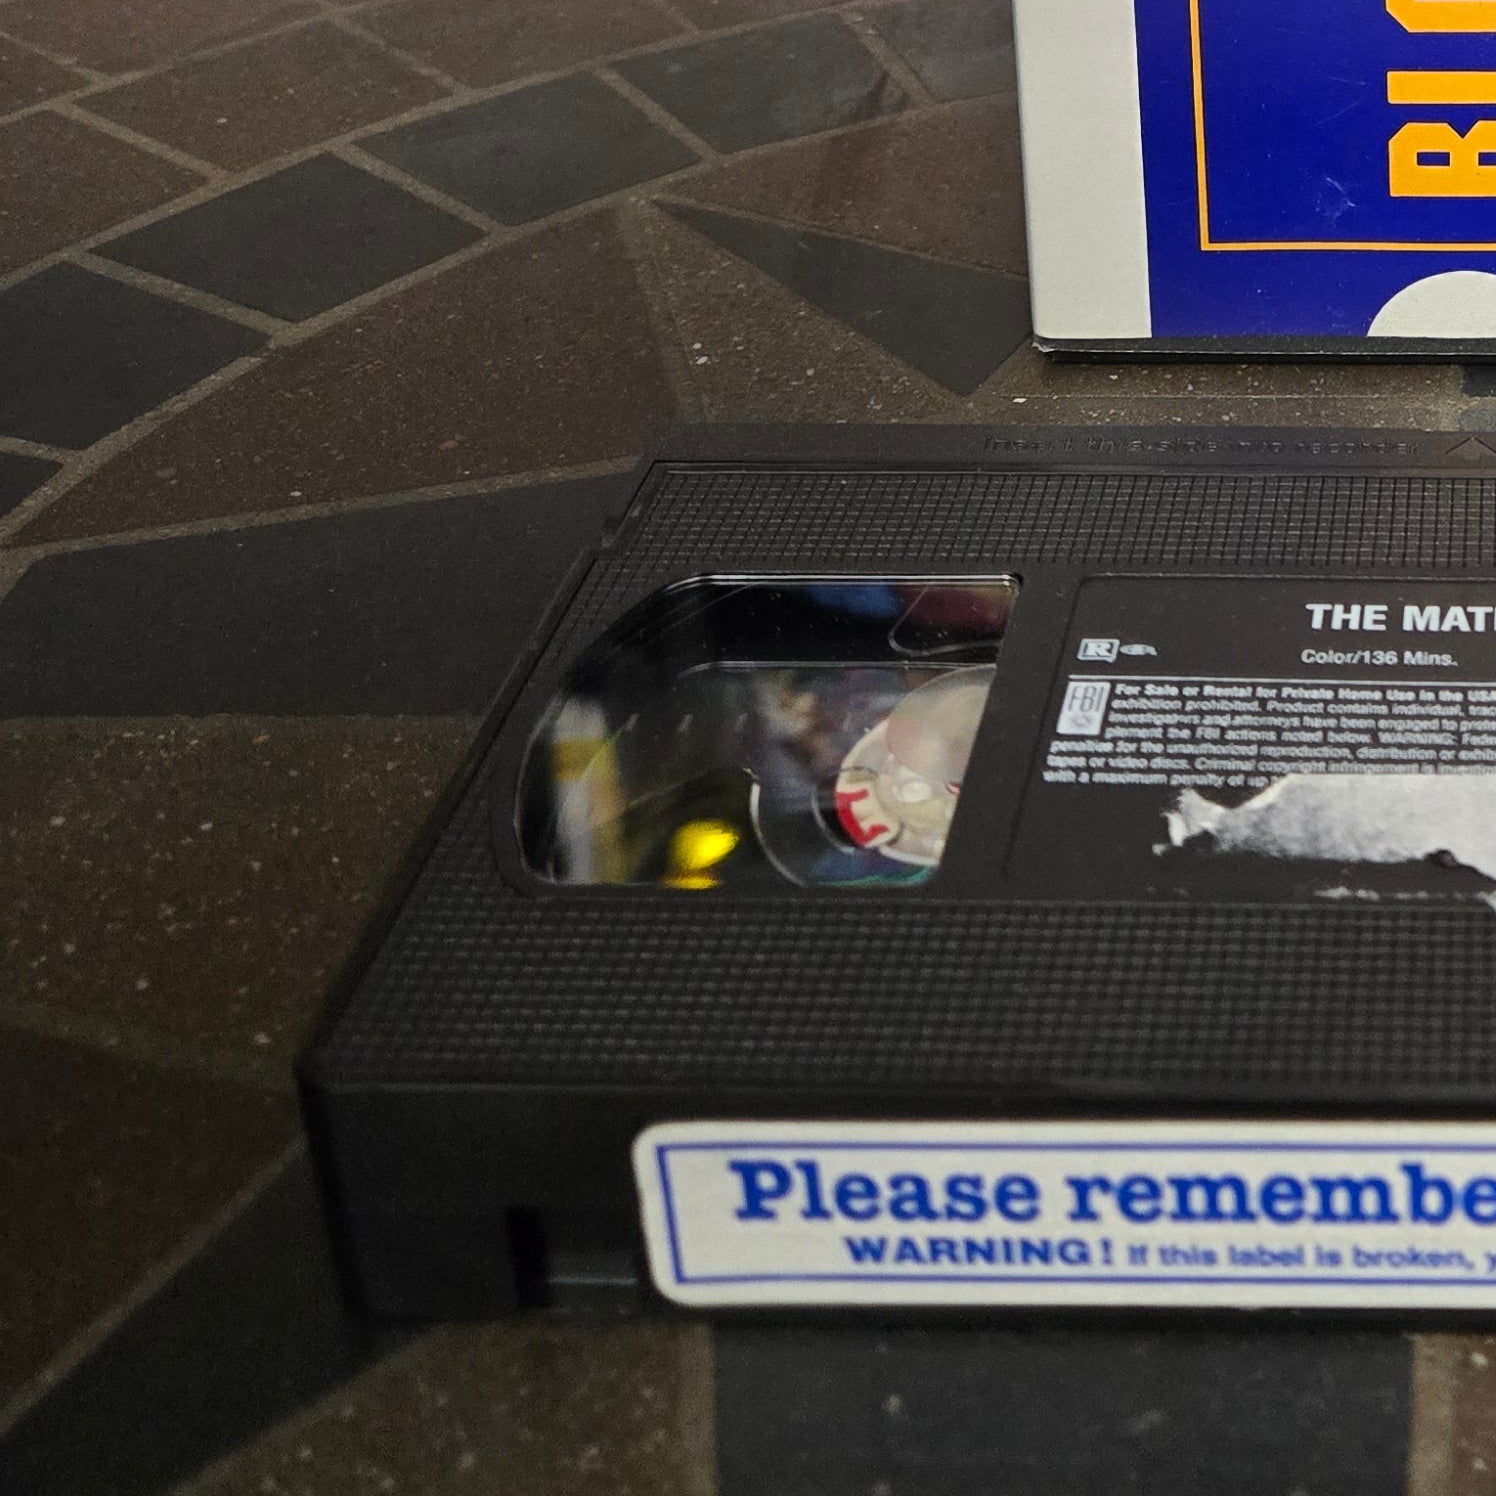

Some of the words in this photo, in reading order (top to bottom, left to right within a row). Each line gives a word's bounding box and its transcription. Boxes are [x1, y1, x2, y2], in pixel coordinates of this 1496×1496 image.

[1304, 602, 1388, 632] THE
[1301, 648, 1398, 666] Color/136
[1402, 649, 1459, 667] Mins.
[1067, 685, 1106, 713] FBI
[731, 1159, 1041, 1223] Please
[844, 1236, 1114, 1267] WARNING!
[1127, 1244, 1148, 1265] If
[1158, 1244, 1219, 1267] this
[1227, 1244, 1304, 1268] label
[1315, 1244, 1343, 1267] is
[1353, 1245, 1475, 1272] broken,
